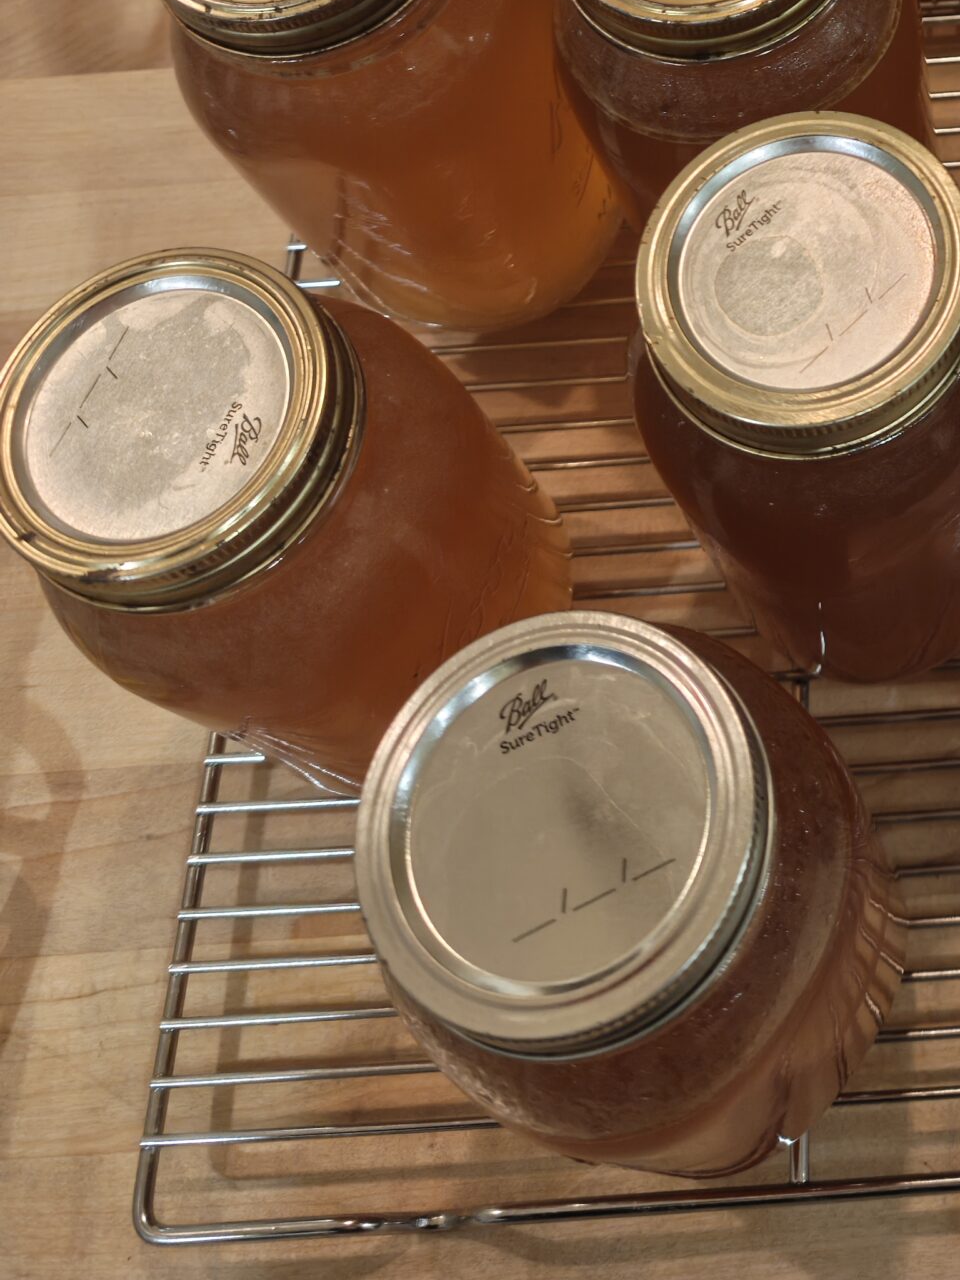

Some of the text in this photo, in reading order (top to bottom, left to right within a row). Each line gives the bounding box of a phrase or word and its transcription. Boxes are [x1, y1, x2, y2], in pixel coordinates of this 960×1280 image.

[715, 189, 757, 238] Ball
[726, 200, 784, 252] SureTight
[199, 401, 243, 473] SureTight
[224, 412, 262, 466] Ball
[499, 678, 558, 735] Ball
[499, 707, 580, 755] SureTight
